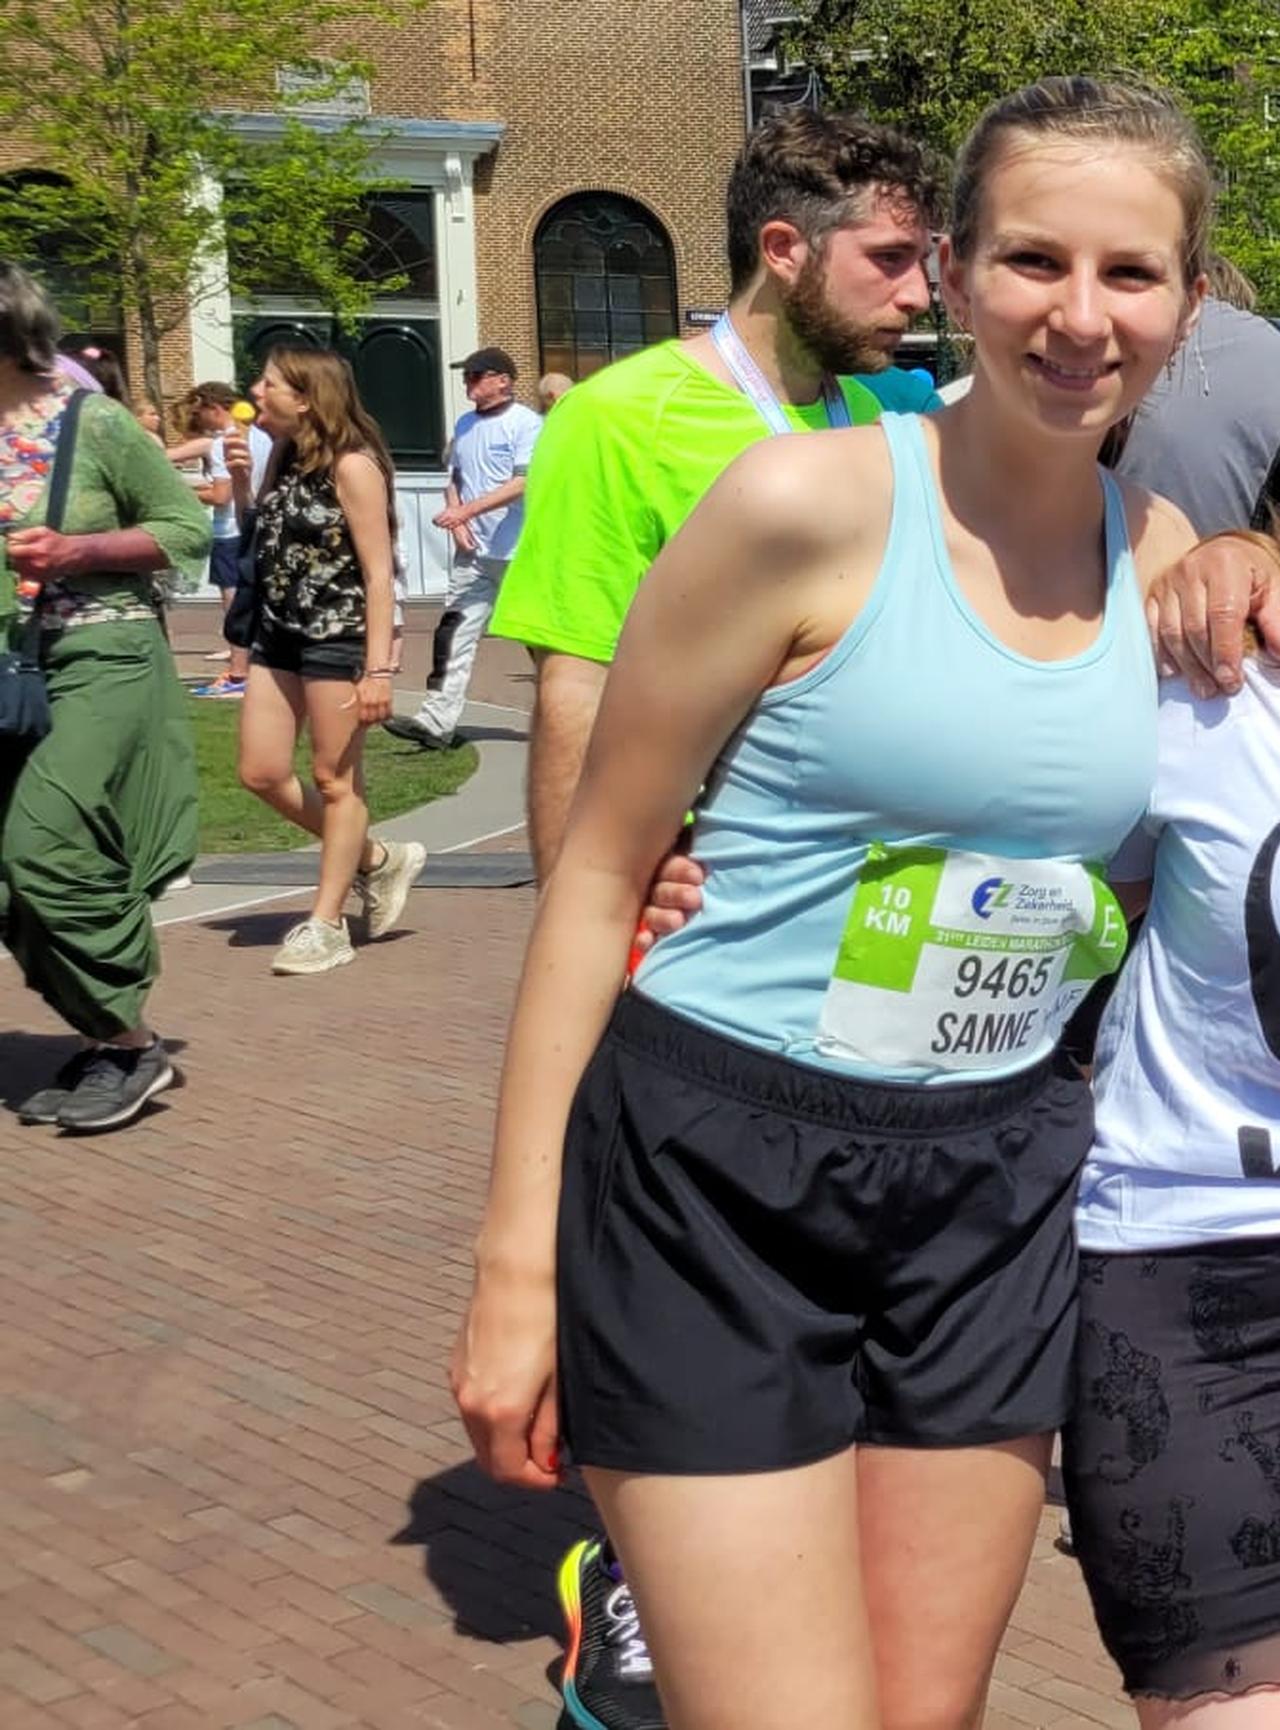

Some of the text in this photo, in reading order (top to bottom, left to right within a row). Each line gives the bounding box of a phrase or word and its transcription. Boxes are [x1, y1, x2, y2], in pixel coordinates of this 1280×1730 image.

[881, 884, 912, 909] 10
[1018, 884, 1046, 900] Zorg
[865, 907, 912, 936] KM
[1097, 905, 1120, 948] E
[954, 955, 1055, 999] 9465
[931, 1009, 1037, 1054] SANNE
